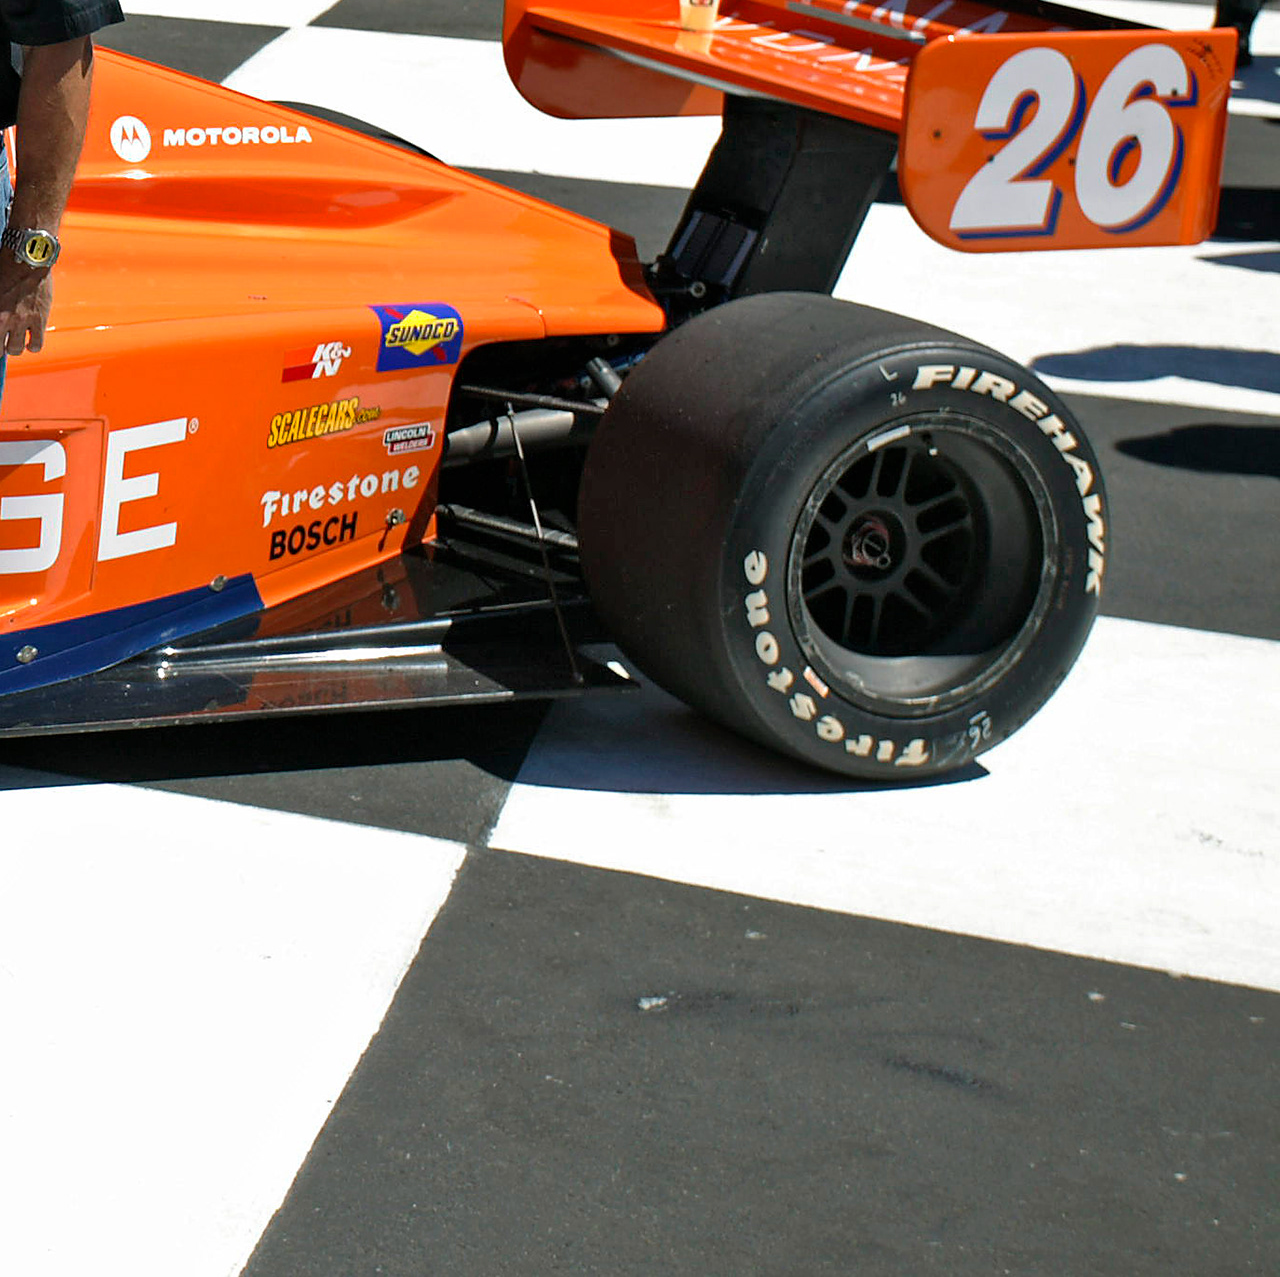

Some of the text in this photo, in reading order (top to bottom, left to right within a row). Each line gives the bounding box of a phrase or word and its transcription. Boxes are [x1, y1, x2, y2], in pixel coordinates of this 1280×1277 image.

[162, 125, 313, 147] MOTOROLA
[948, 42, 1194, 233] 26
[384, 319, 459, 350] SUNOCO
[386, 426, 427, 442] LINCOLN
[260, 464, 420, 529] Firestone
[911, 364, 1106, 599] FIREHAWK
[269, 511, 358, 562] BOSCH
[743, 549, 930, 768] Firestone
